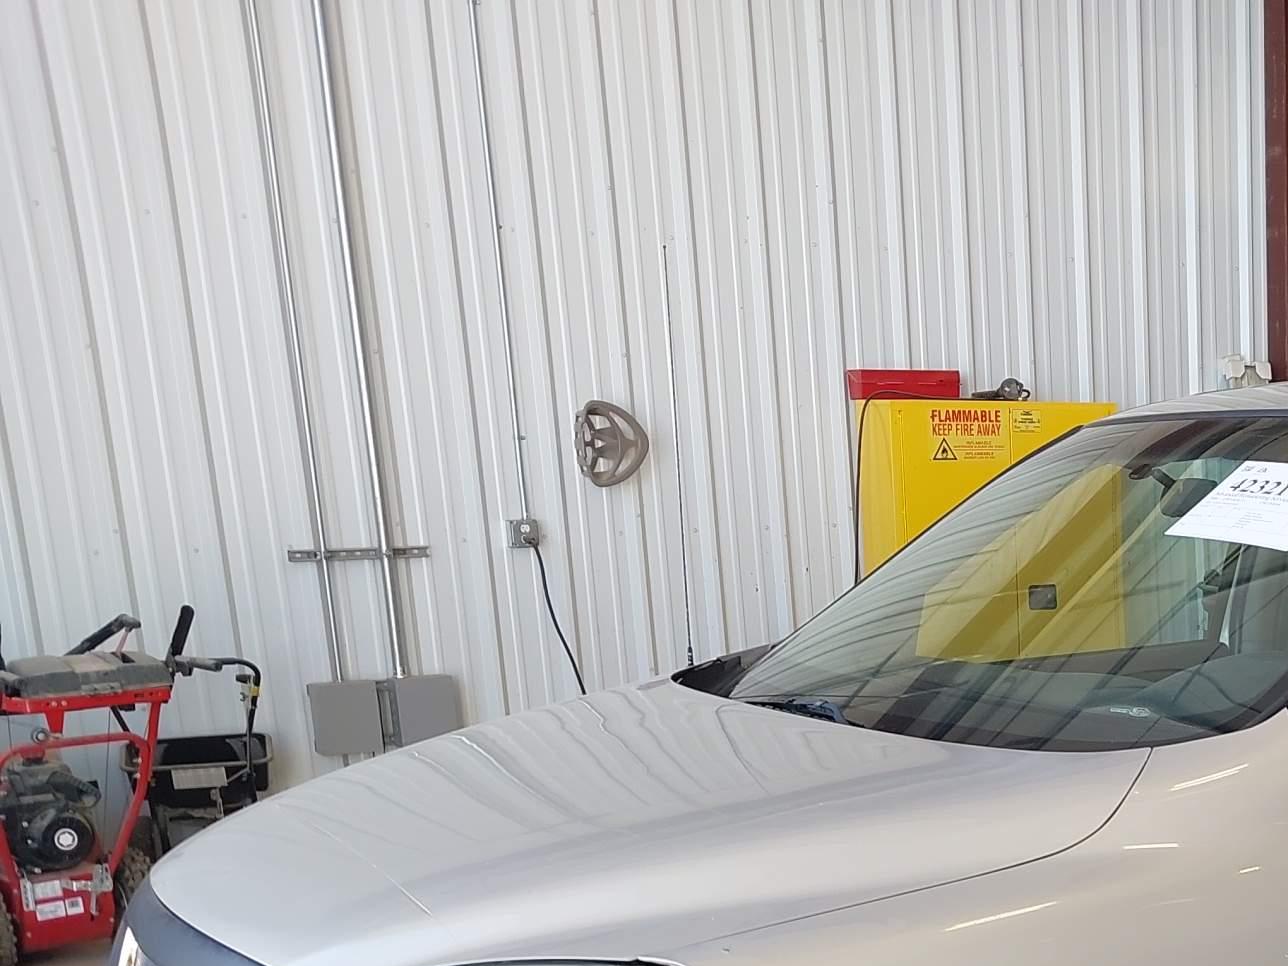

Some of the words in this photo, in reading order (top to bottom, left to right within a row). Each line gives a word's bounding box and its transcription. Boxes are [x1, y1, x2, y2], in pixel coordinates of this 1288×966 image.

[931, 409, 1001, 423] FLAMMABLE
[932, 423, 953, 437] KEEP
[955, 423, 975, 437] FIRE
[976, 423, 1002, 437] AWAY
